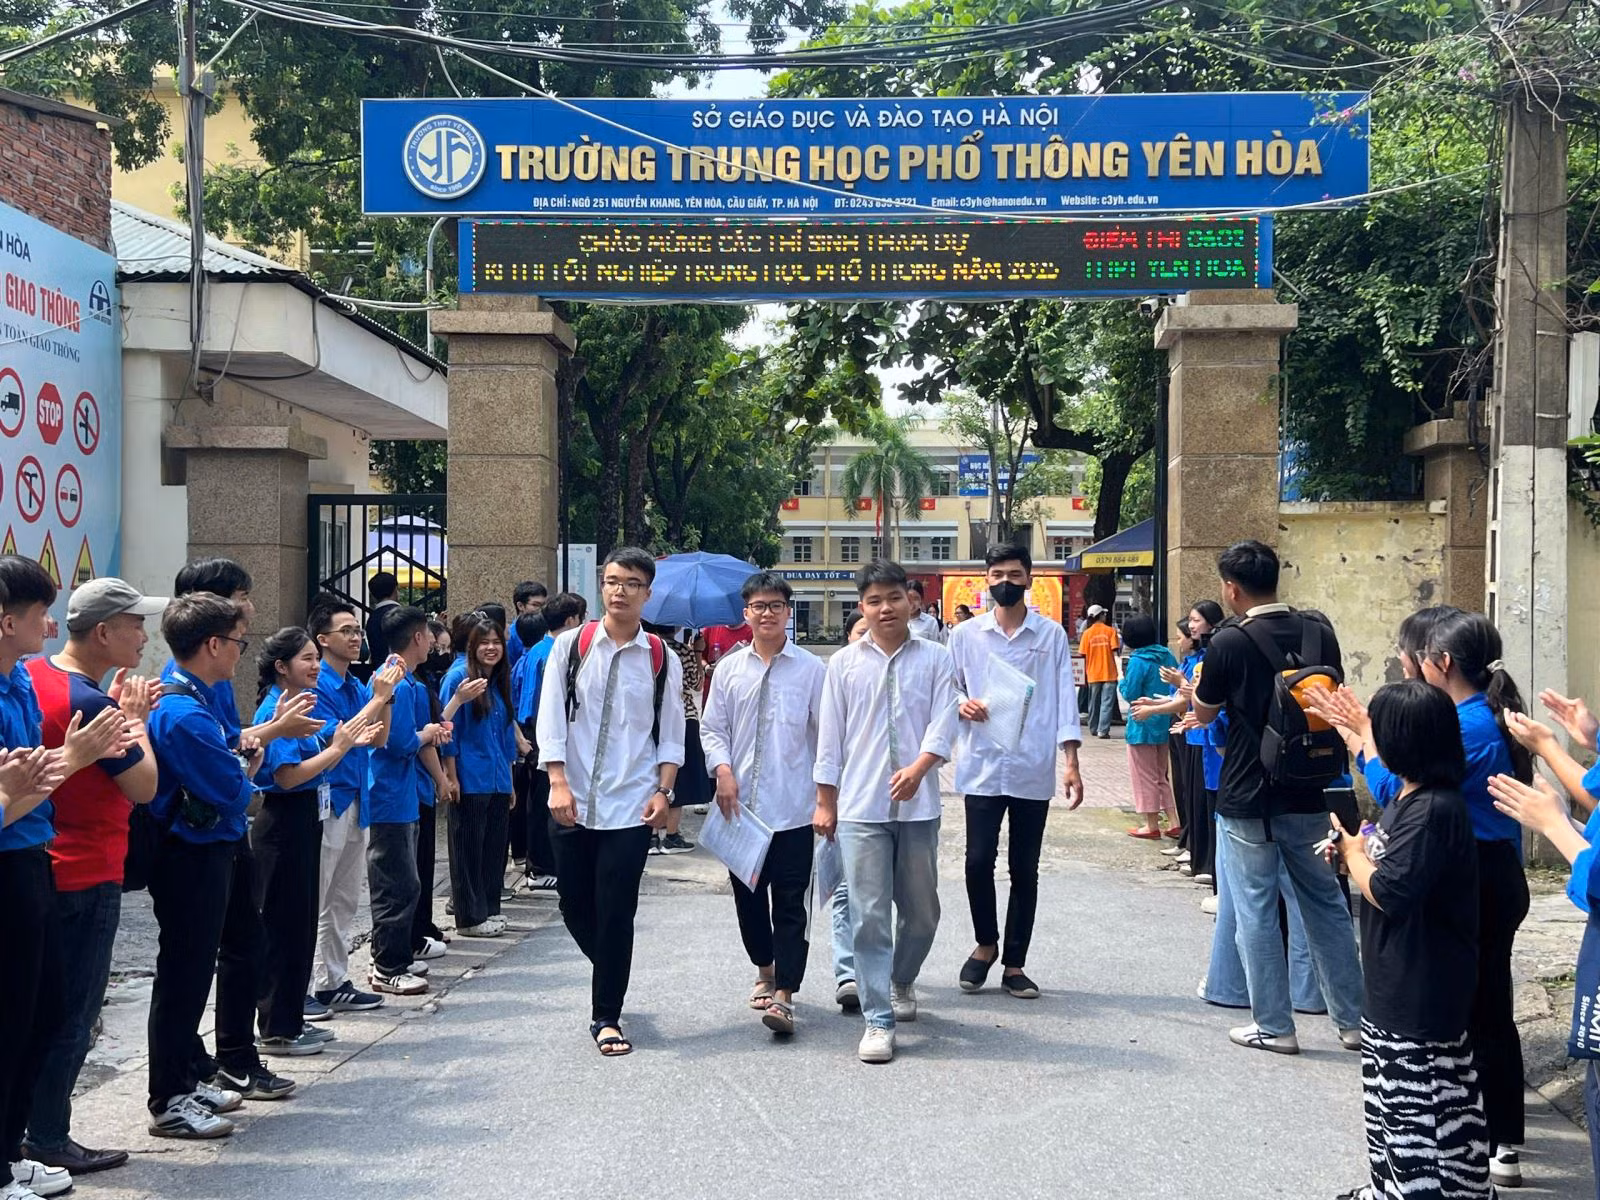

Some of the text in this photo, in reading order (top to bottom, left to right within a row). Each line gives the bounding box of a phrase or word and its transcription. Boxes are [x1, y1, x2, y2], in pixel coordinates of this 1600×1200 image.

[692, 102, 1059, 133] SỞ GIÁO DỤC VÀ ĐÀO TẠO HÀ NỘI
[494, 129, 1324, 190] TRƯỜNG TRUNG HỌC PHỔ THÔNG YÊN HÒA
[592, 197, 609, 209] 251
[650, 197, 683, 210] KHANG,
[685, 195, 702, 209] YÊN
[772, 197, 786, 209] TP.
[787, 195, 800, 209] HÀ
[803, 196, 818, 211] NỘI
[931, 196, 959, 208] Email:
[1060, 195, 1100, 206] Website:
[1101, 194, 1159, 206] c3yh.edu.vn
[6, 232, 32, 263] HÒA
[5, 272, 81, 334] GIAO THÔNG
[39, 398, 62, 428] STOP
[1576, 995, 1591, 1050] Since 2010
